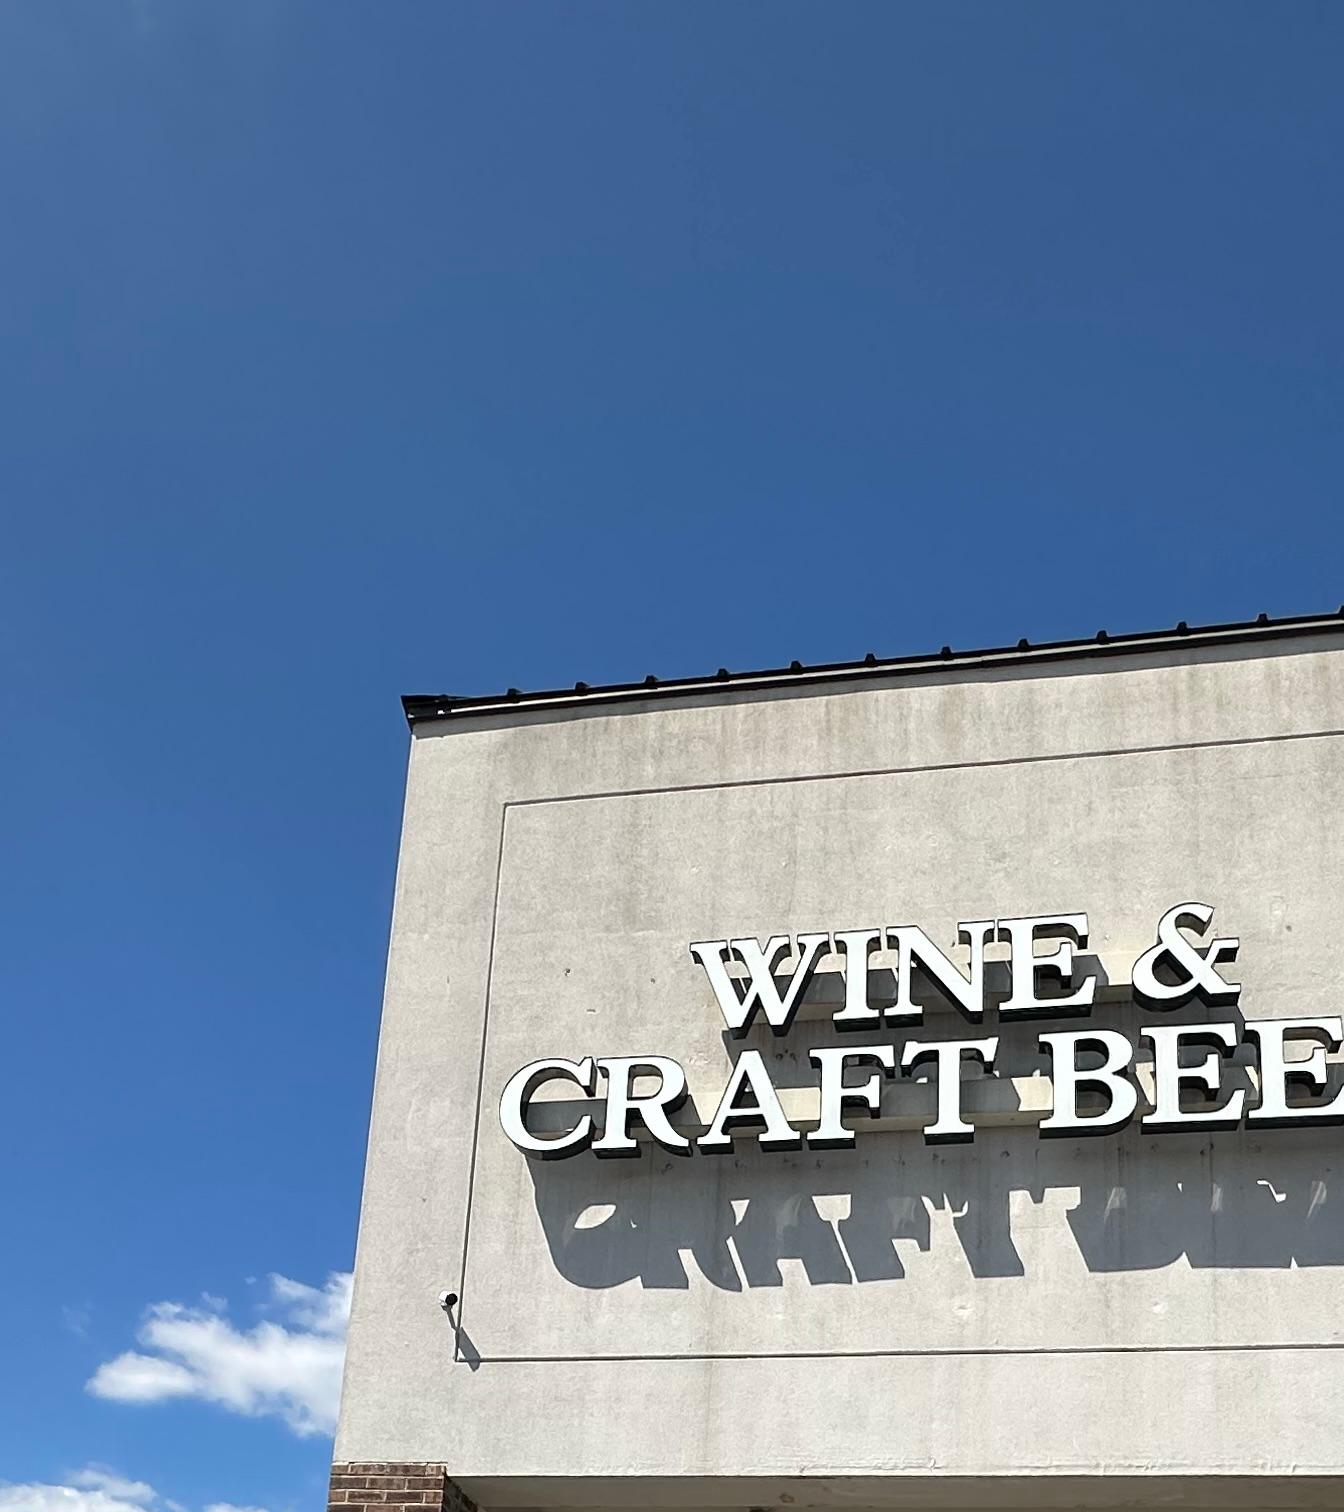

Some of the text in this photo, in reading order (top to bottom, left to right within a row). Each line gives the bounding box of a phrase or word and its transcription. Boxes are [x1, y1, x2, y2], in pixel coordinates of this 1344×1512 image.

[690, 901, 1242, 1034] WINE &
[498, 1036, 1000, 1158] CRAFT
